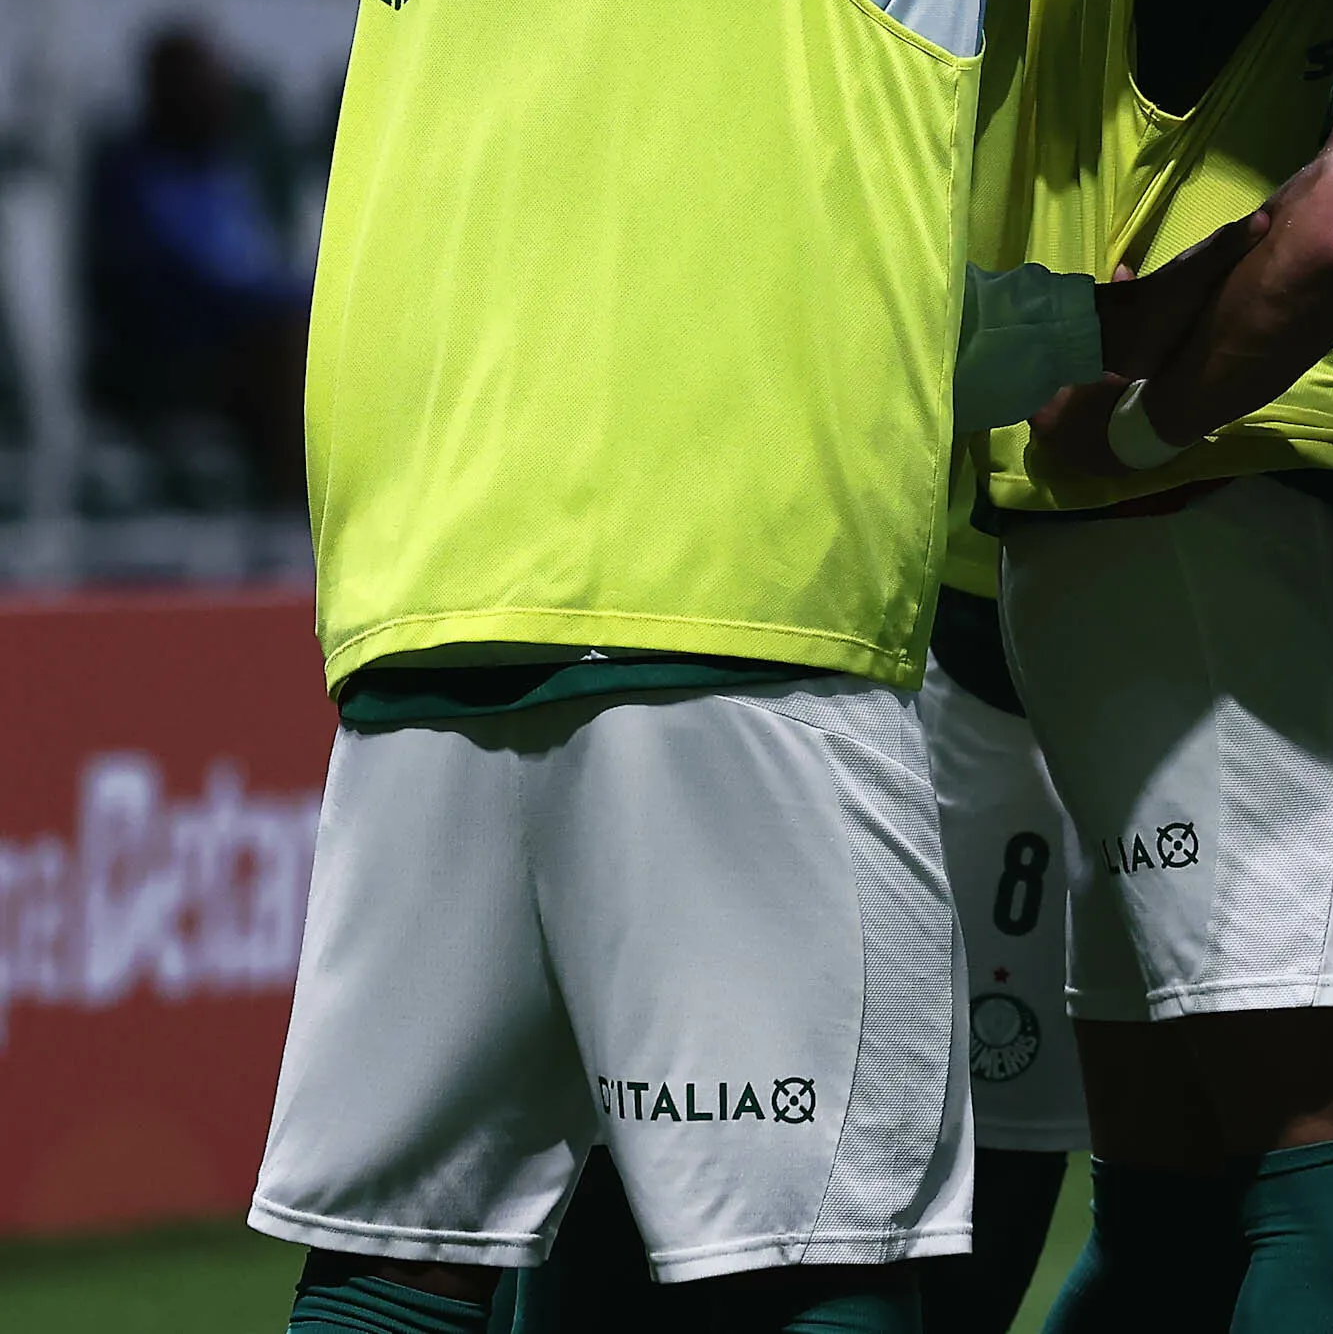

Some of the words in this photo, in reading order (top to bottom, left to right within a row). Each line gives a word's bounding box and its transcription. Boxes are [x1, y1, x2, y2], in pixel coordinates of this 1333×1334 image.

[1102, 833, 1155, 875] LIA
[992, 831, 1050, 936] 8
[598, 1076, 766, 1122] D'ITALIA
